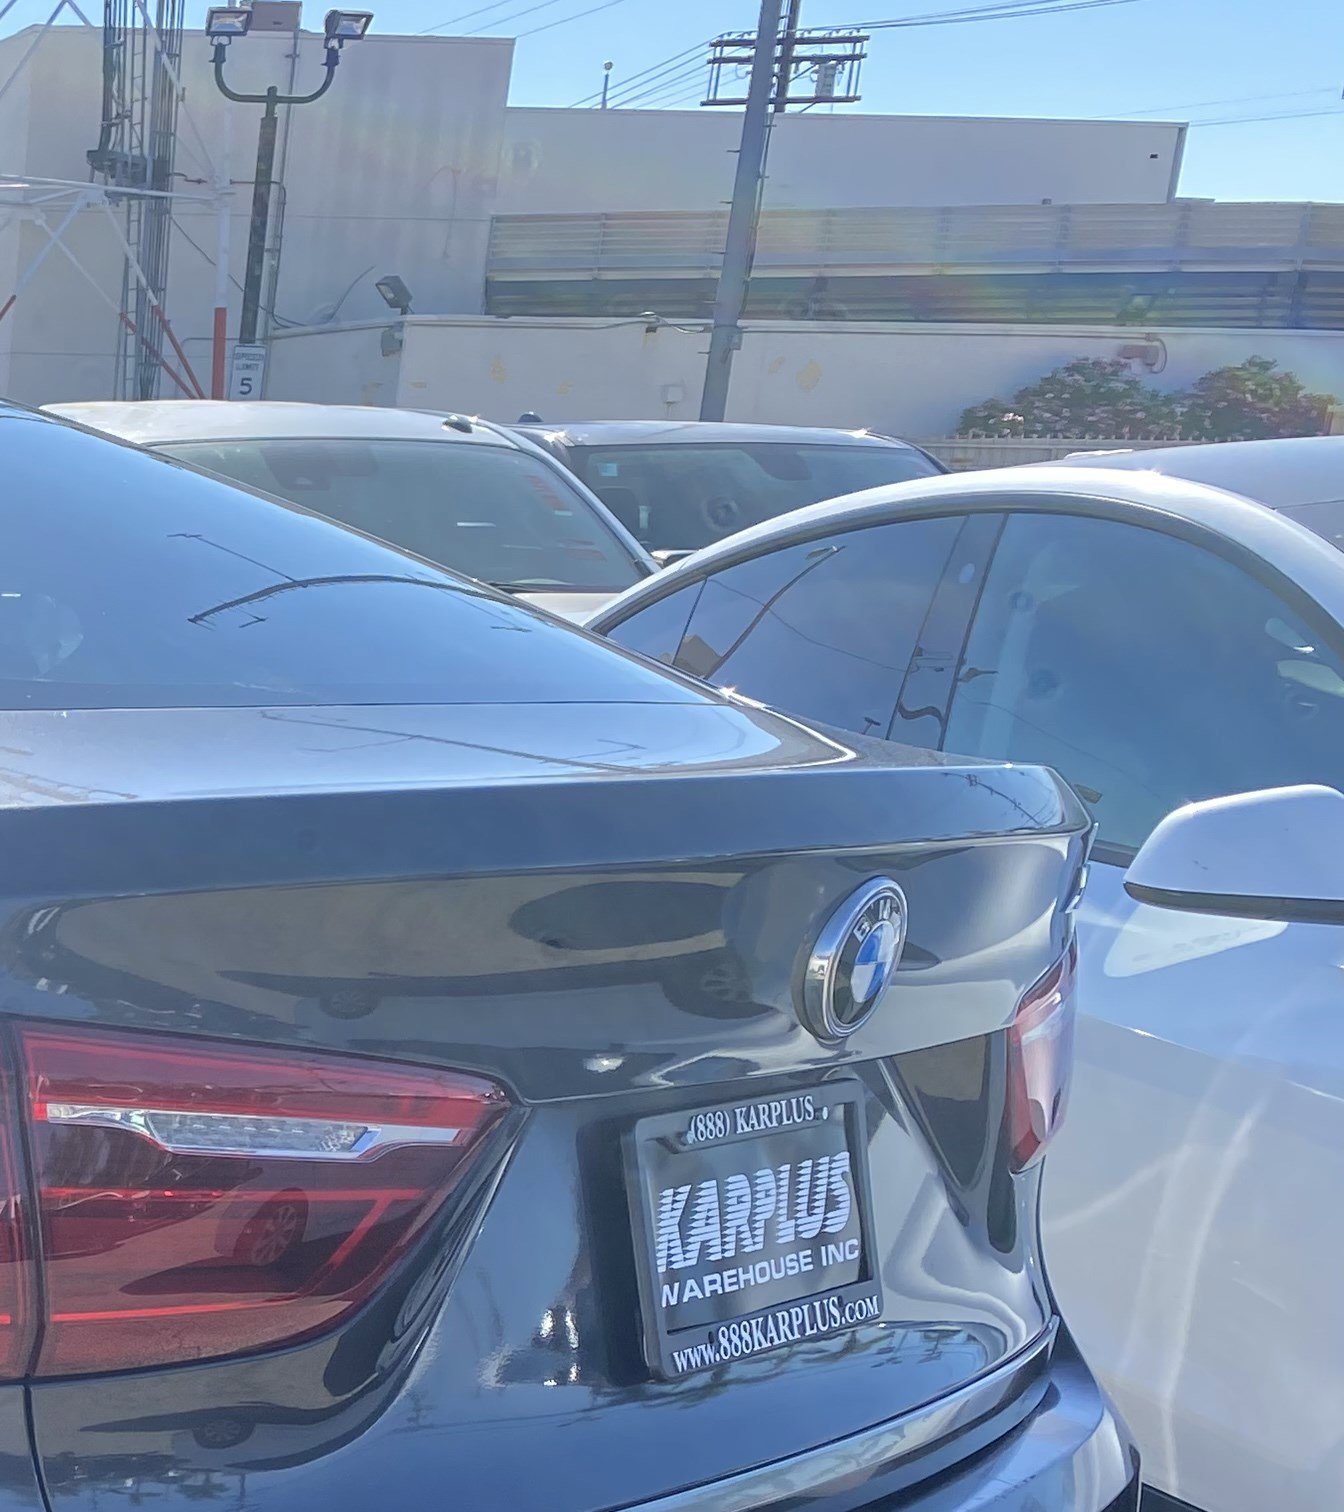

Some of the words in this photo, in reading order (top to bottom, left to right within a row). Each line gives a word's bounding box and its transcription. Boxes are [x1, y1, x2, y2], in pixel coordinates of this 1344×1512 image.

[239, 377, 253, 395] 5
[690, 1110, 731, 1141] (888)
[734, 1095, 815, 1134] KARPLUS
[656, 1151, 851, 1273] KARPLUS
[662, 1249, 814, 1308] WAREHOUSE
[821, 1238, 860, 1267] INC
